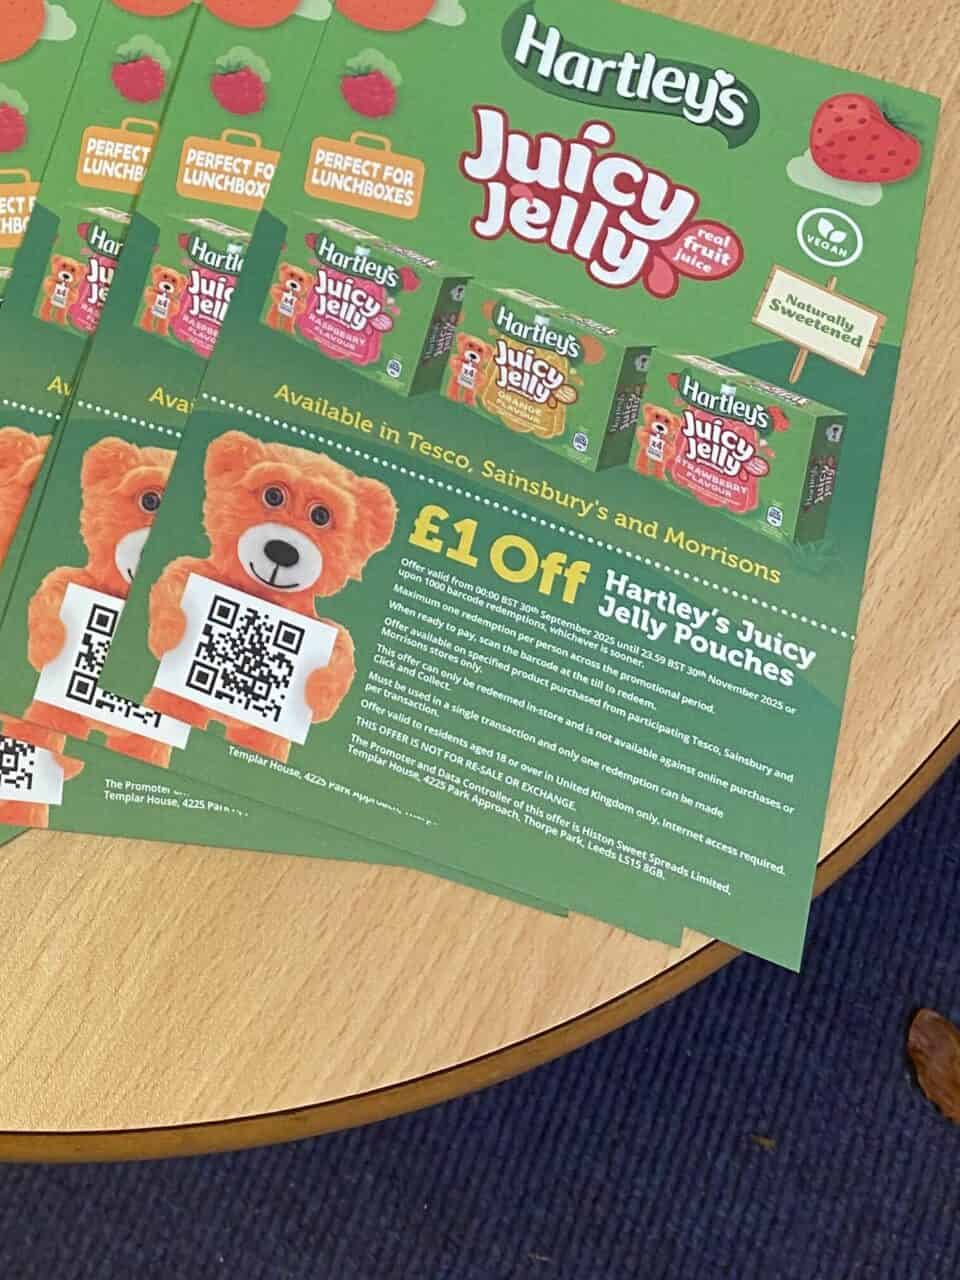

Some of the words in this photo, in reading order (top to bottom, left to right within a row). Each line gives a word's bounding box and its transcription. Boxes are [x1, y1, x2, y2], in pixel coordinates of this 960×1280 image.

[514, 13, 749, 128] Hartley's
[86, 138, 151, 163] PERFECT
[185, 148, 252, 172] PERFECT
[255, 160, 276, 180] FO
[314, 149, 381, 180] PERFECT
[382, 168, 415, 187] FOR
[311, 170, 415, 208] LUNCHBOXES
[464, 108, 695, 241] Juicy
[471, 181, 650, 287] Jelly
[683, 234, 732, 268] fruit
[697, 227, 731, 248] real
[806, 234, 848, 257] VEGAN
[318, 237, 399, 288] Hartley's
[674, 250, 713, 274] juice
[315, 271, 381, 317] Juicy
[316, 295, 368, 331] Jelly
[785, 292, 856, 334] Naturally
[497, 306, 581, 358] Hartley's
[768, 296, 864, 350] Sweetened
[495, 341, 565, 389] Juicy
[496, 365, 551, 403] Jelly
[683, 375, 769, 429] Hartley's
[683, 411, 755, 461] Juicy
[686, 438, 741, 476] Jelly
[273, 383, 374, 433] Available
[379, 422, 401, 445] in
[407, 431, 473, 474] Tesco,
[481, 460, 609, 517] Sainsbury's
[614, 511, 658, 540] and
[663, 526, 782, 584] Morrisons
[408, 504, 479, 569] £1
[489, 534, 591, 605] Off
[398, 568, 423, 583] upon
[425, 577, 446, 592] 1000
[446, 585, 485, 607] barcode
[549, 627, 599, 650] whichever
[599, 644, 609, 655] is
[605, 569, 730, 635] Hartley's
[737, 619, 817, 670] Juicy
[381, 627, 428, 652] Morrisons
[429, 647, 459, 664] stores
[389, 599, 416, 617] When
[417, 612, 445, 630] ready
[445, 622, 457, 633] to
[456, 628, 477, 643] pay,
[478, 636, 501, 650] scan
[502, 644, 520, 657] the
[520, 650, 559, 673] barcode
[559, 667, 572, 678] at
[572, 671, 590, 685] the
[590, 678, 605, 690] till
[604, 683, 616, 695] to
[617, 689, 657, 711] redeem.
[393, 583, 441, 608] Maximum
[442, 603, 461, 616] one
[461, 611, 517, 638] redemption
[517, 633, 535, 644] per
[535, 639, 569, 658] person
[569, 652, 601, 670] across
[602, 664, 619, 678] the
[619, 672, 681, 700] promotional
[681, 695, 715, 715] period.
[400, 558, 426, 573] Offer
[427, 568, 451, 582] valid
[451, 575, 474, 592] from
[475, 585, 500, 601] 00:00
[501, 595, 520, 608] BST
[540, 610, 592, 636] September
[593, 630, 616, 645] 2025
[616, 640, 640, 655] until
[640, 648, 667, 665] 23.59
[667, 658, 687, 672] BST
[707, 674, 760, 700] November
[760, 694, 784, 710] 2025
[784, 706, 797, 715] or
[597, 594, 668, 641] Jelly
[674, 621, 795, 687] Pouches
[364, 683, 383, 695] per
[373, 654, 396, 670] Click
[396, 665, 417, 678] and
[104, 778, 123, 790] The
[228, 746, 267, 767] Templar
[269, 761, 302, 780] House,
[360, 699, 386, 715] Offer
[387, 710, 412, 725] valid
[411, 719, 423, 730] to
[424, 725, 468, 748] residents
[469, 743, 494, 758] aged
[507, 758, 520, 768] or
[520, 763, 544, 777] over
[543, 770, 555, 783] in
[555, 775, 590, 796] United
[590, 789, 635, 815] Kingdom
[662, 818, 704, 843] Internet
[704, 837, 738, 856] access
[103, 790, 145, 805] Templar
[146, 794, 181, 808] House,
[182, 798, 206, 810] 4225
